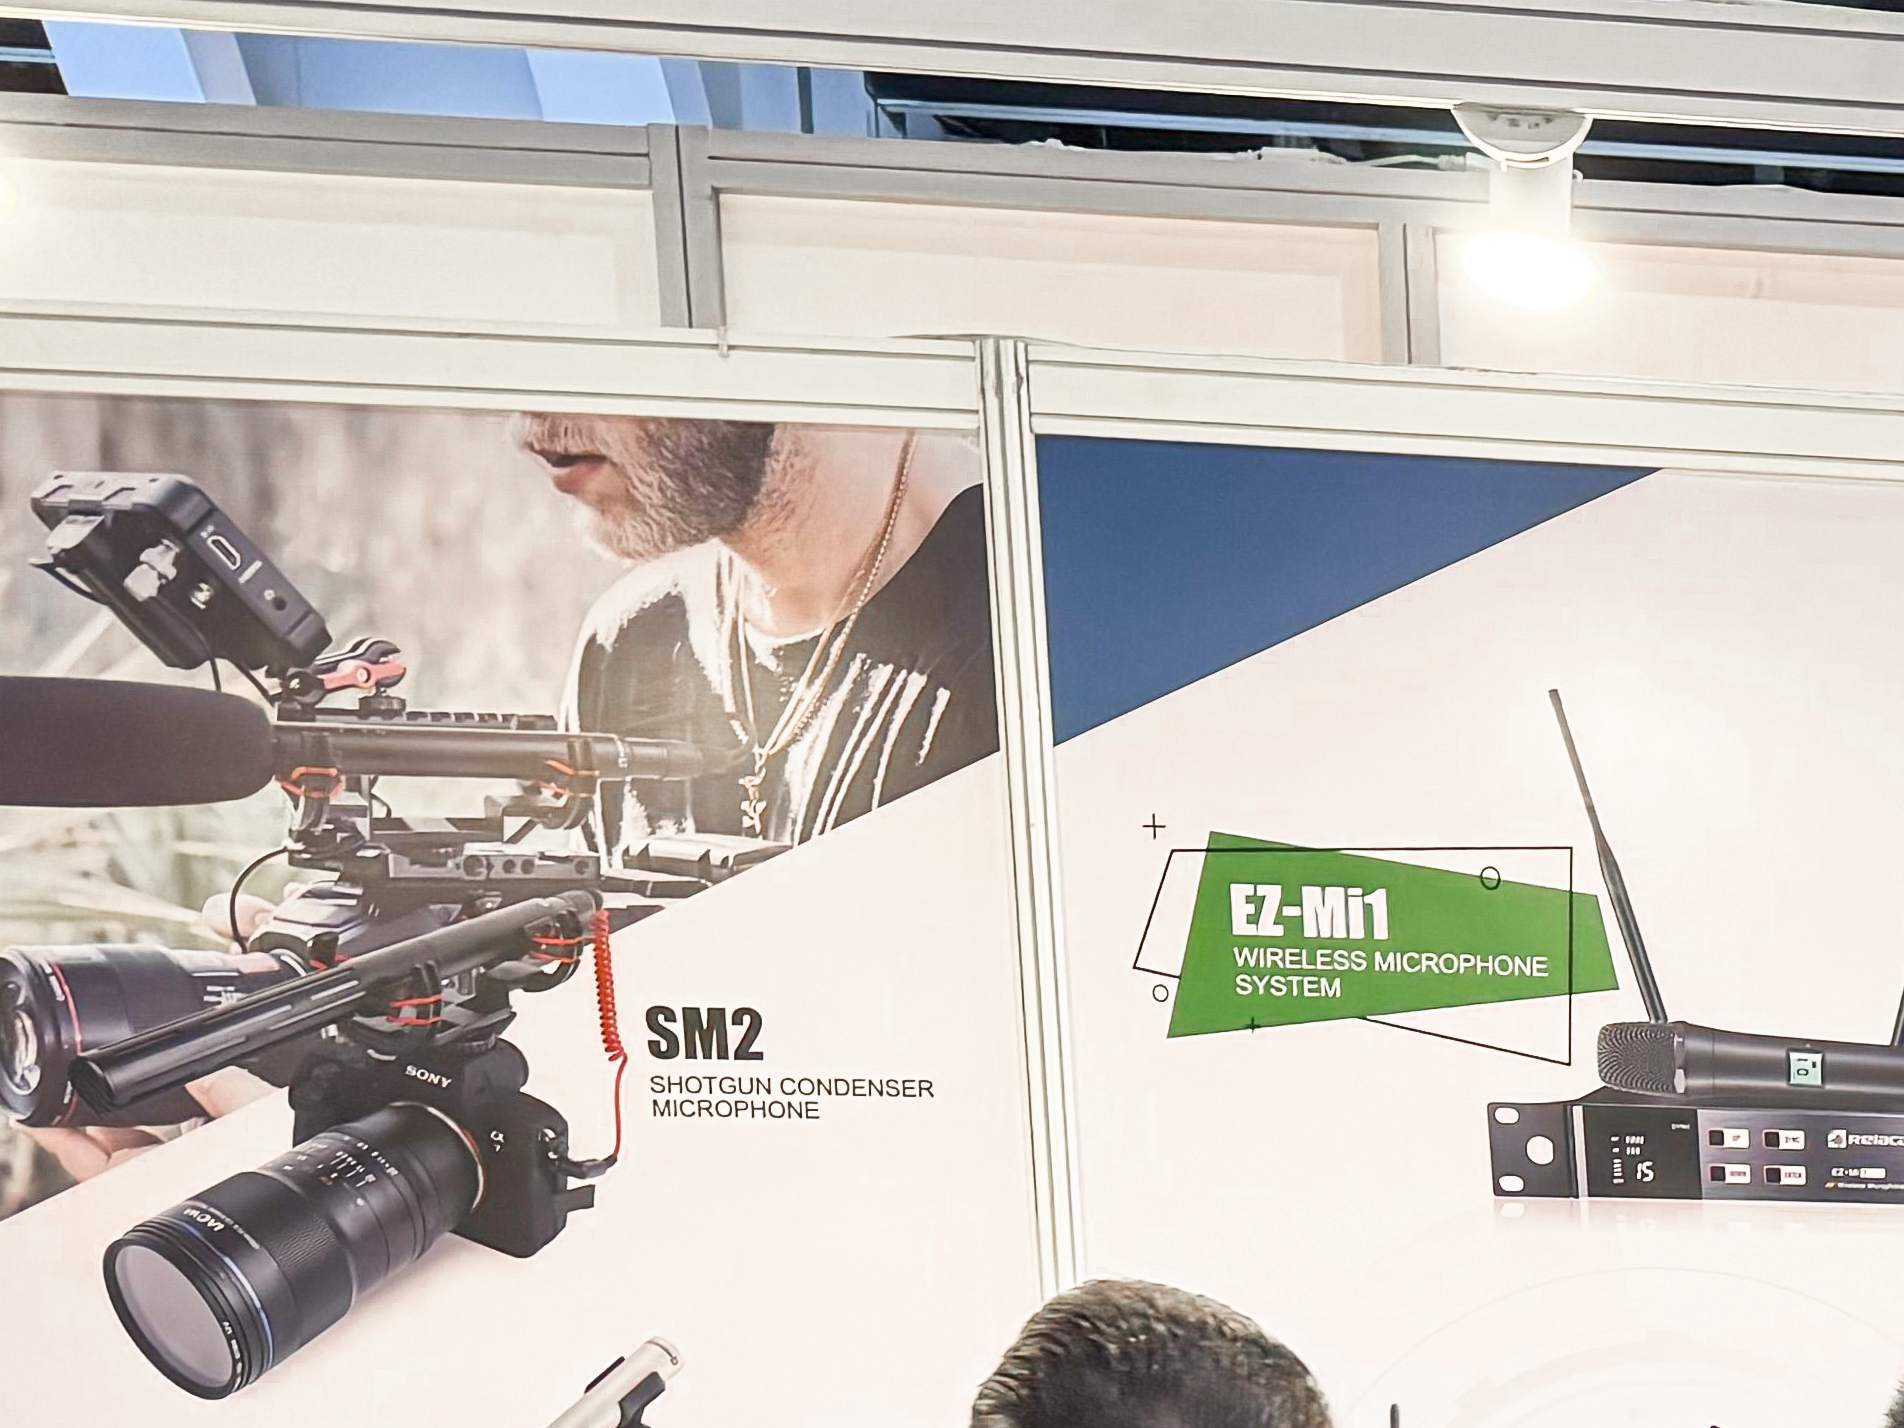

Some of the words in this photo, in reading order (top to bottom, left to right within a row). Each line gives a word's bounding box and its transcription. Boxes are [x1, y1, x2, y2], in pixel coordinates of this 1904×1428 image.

[1229, 883, 1390, 941] EZ-Mi1
[1233, 947, 1368, 972] WIRELESS
[1374, 951, 1549, 978] MICROPHONE
[1235, 975, 1342, 998] SYSTEM
[645, 1005, 764, 1061] SM2
[404, 1064, 453, 1089] SONY
[650, 1075, 771, 1096] SHOTGUN
[780, 1077, 934, 1098] CONDENSER
[652, 1099, 820, 1119] MICROPHONE
